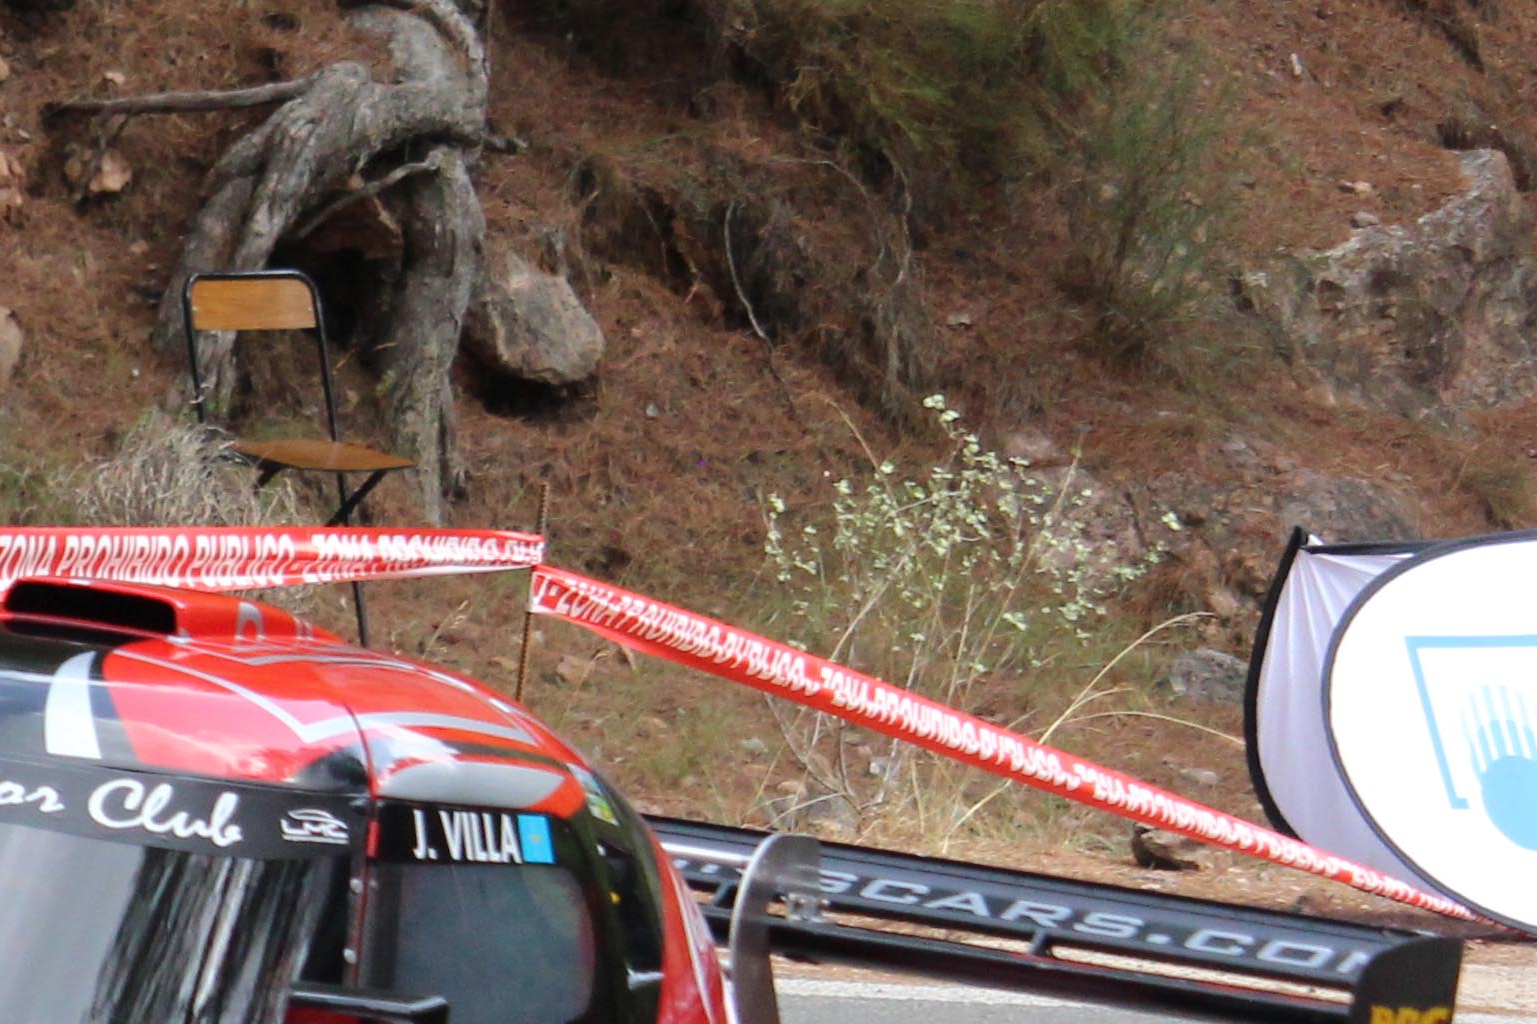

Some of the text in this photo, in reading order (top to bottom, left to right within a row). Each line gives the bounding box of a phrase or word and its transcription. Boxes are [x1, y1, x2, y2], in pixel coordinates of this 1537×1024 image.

[55, 535, 190, 587] PROHIBIDO
[88, 778, 244, 847] Club
[412, 808, 523, 864] J. VILLA
